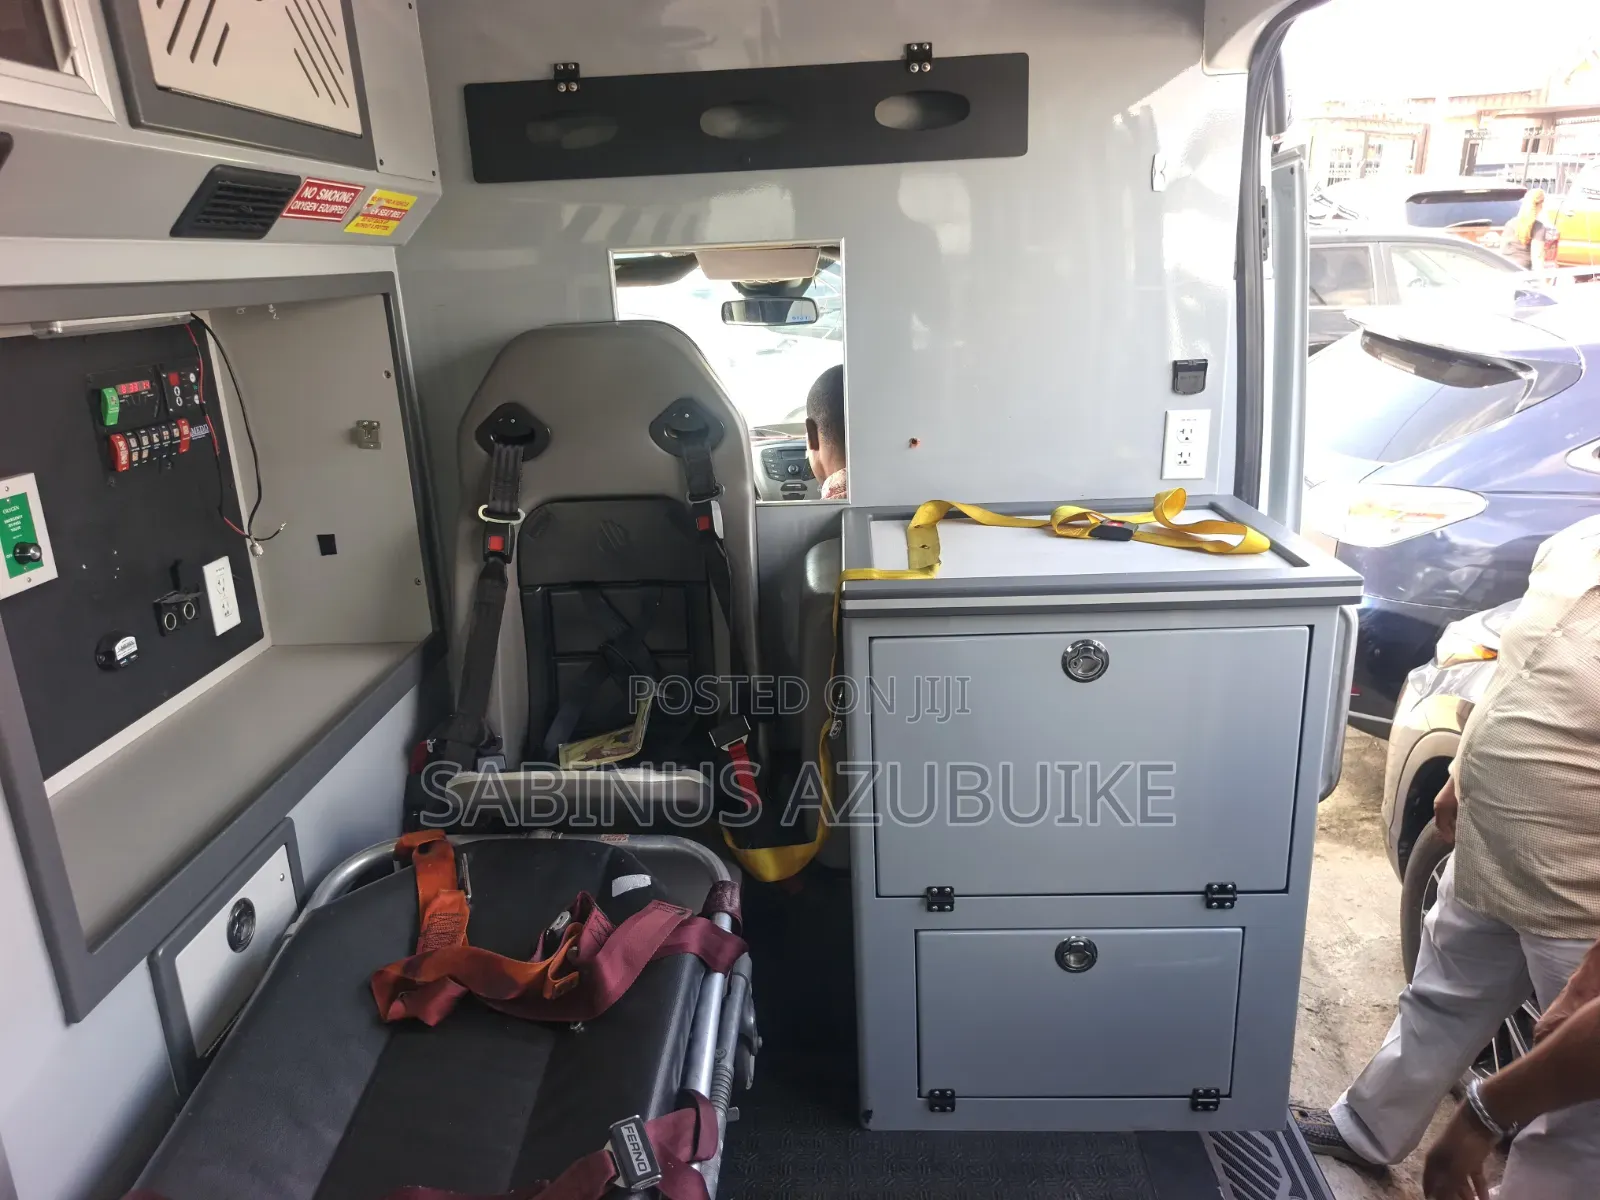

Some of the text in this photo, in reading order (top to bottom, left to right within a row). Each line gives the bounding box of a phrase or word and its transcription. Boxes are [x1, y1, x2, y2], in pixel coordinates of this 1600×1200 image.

[301, 186, 355, 203] NO SMOKING
[291, 200, 348, 215] OXYGEN EQUIPPED
[378, 208, 393, 217] SEAT
[391, 210, 406, 218] BELT
[2, 505, 20, 514] OXYGEN
[624, 1125, 648, 1172] FERNO
